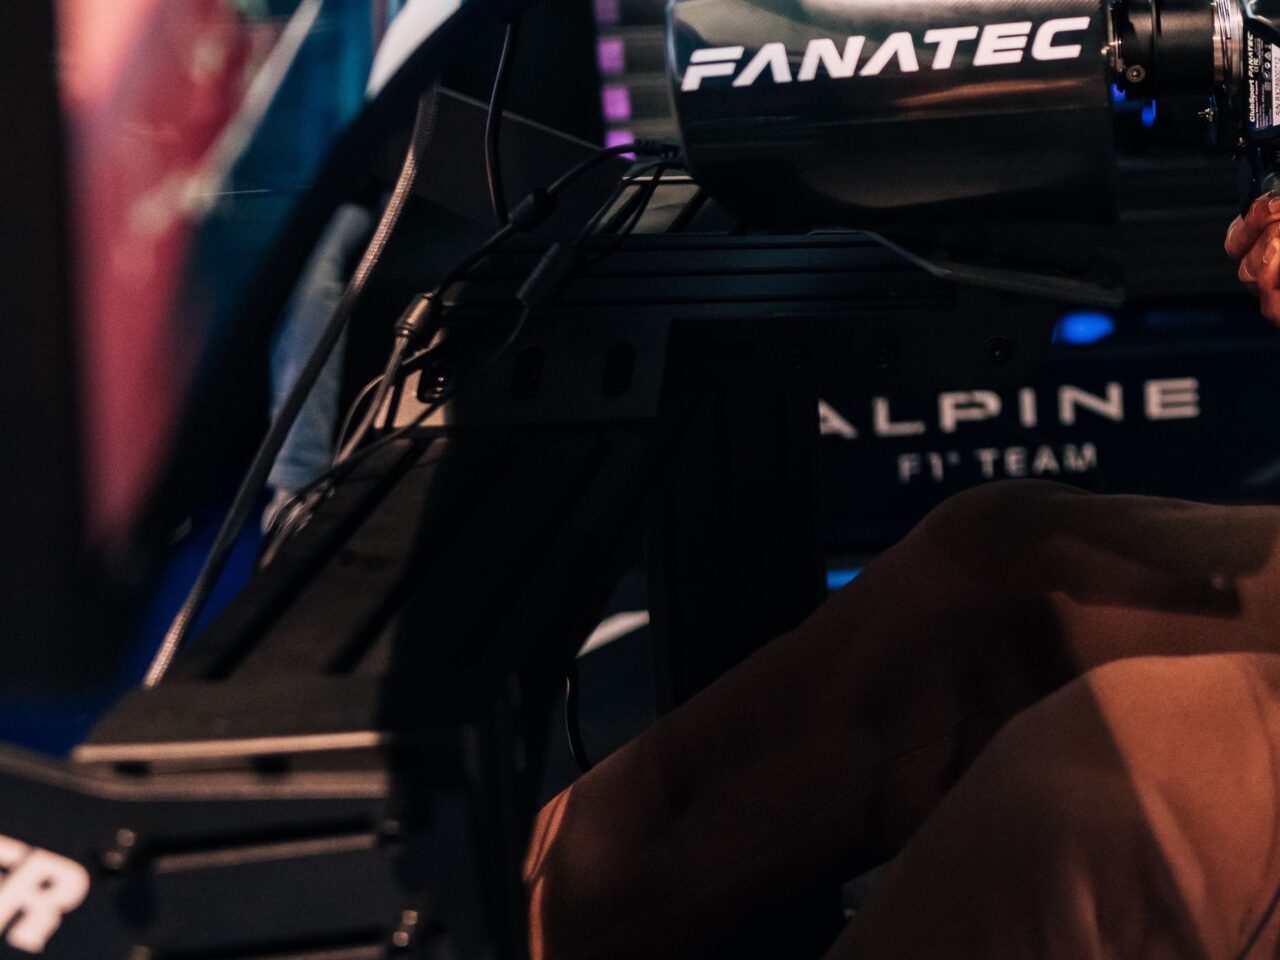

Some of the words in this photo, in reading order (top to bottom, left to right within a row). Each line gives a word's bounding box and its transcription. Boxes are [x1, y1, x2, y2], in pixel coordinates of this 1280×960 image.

[680, 16, 1091, 92] FANATEC
[818, 377, 1201, 439] ALPINE
[976, 442, 1098, 477] TEAM
